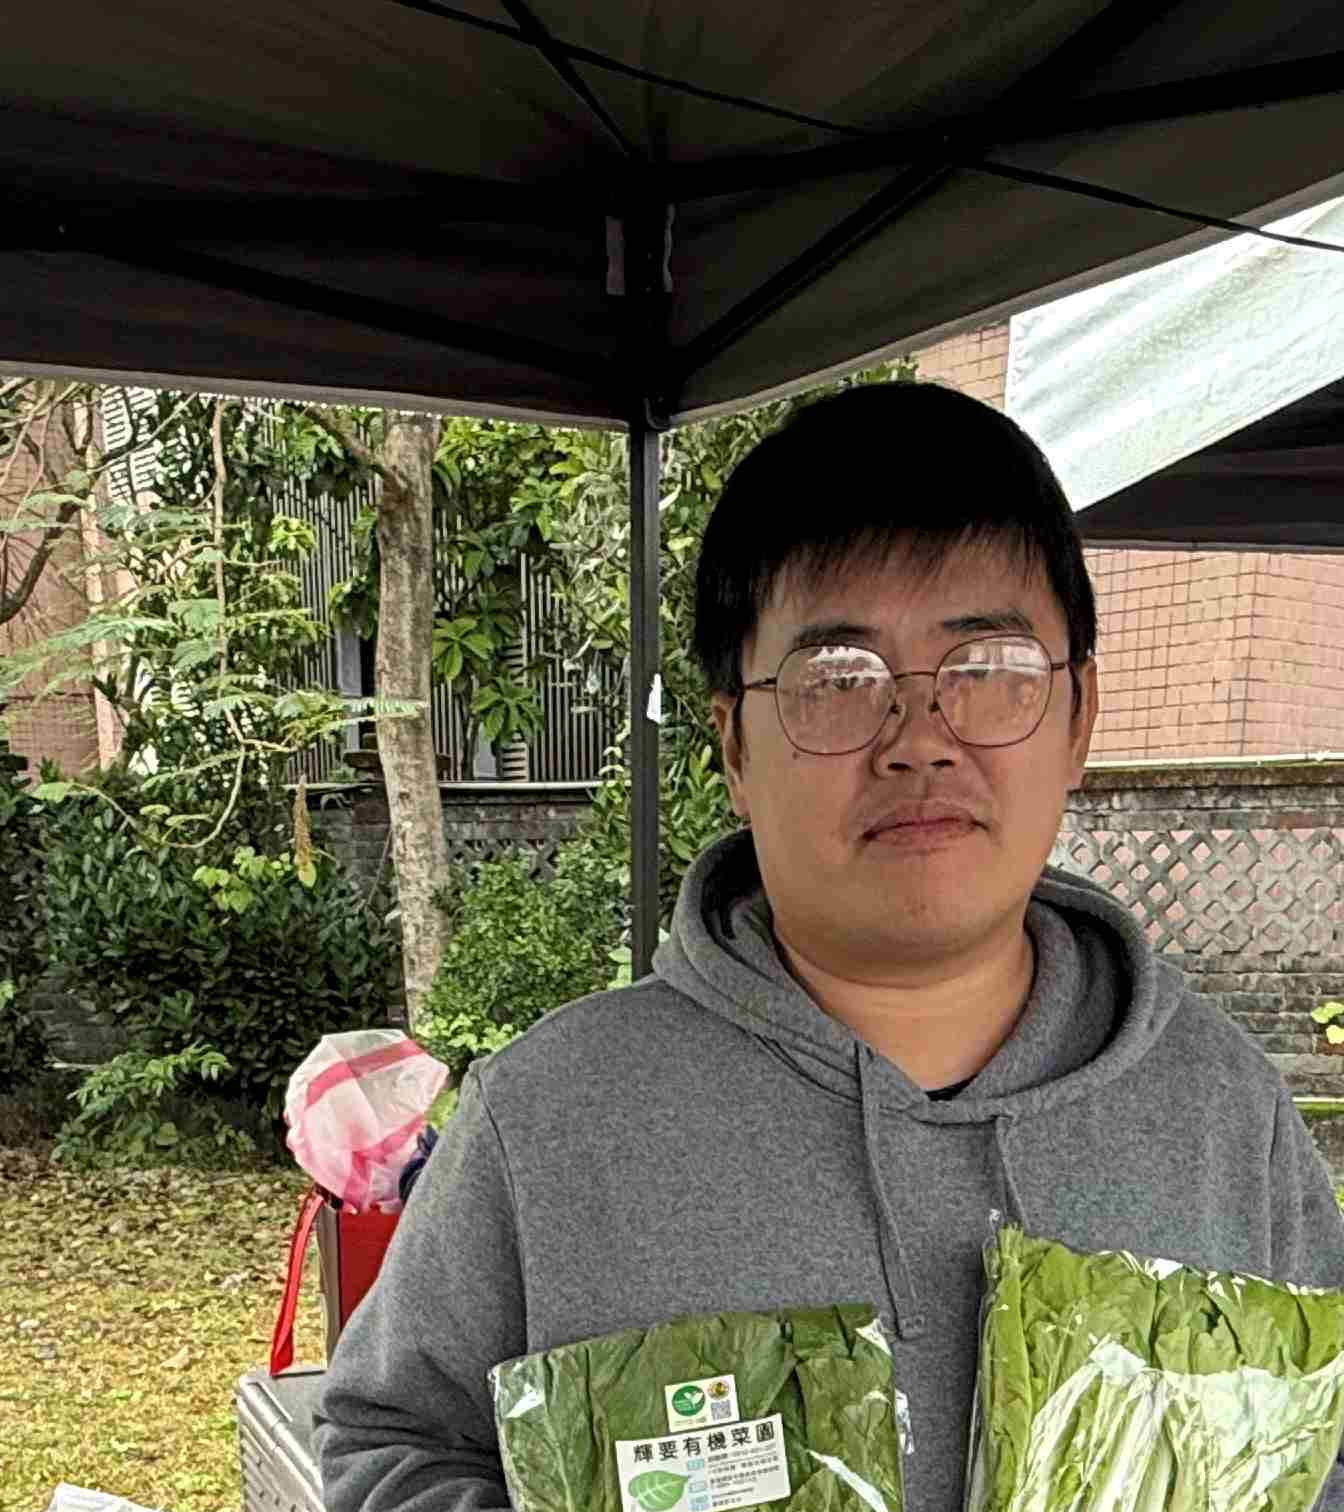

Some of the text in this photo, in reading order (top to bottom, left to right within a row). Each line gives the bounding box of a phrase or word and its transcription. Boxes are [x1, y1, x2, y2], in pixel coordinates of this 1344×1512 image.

[632, 1420, 775, 1464] 輝要有機菜園
